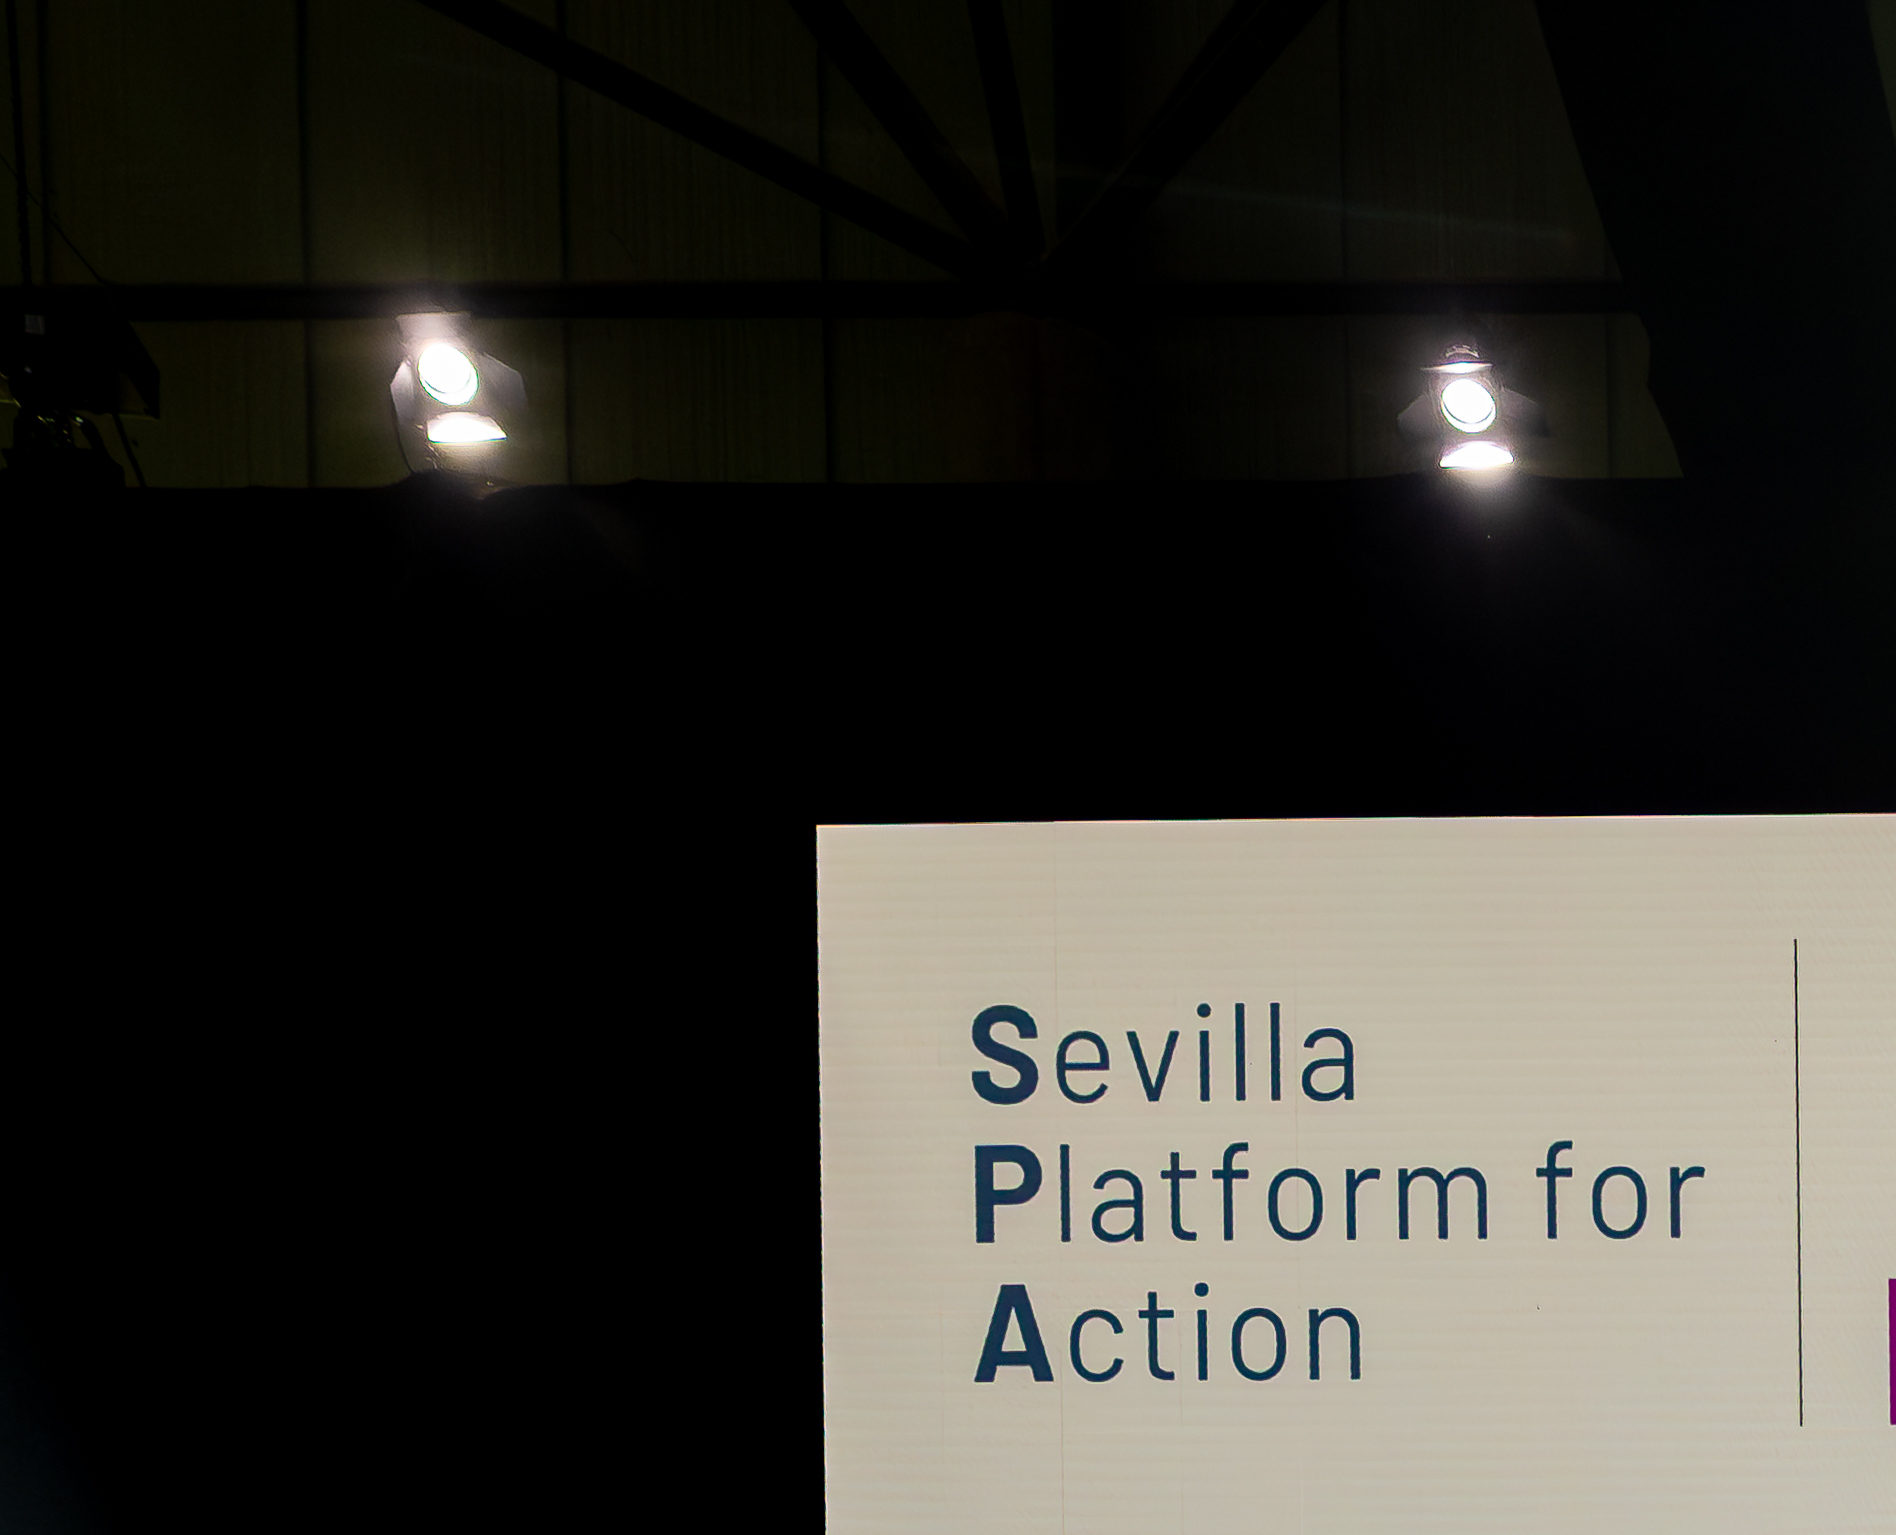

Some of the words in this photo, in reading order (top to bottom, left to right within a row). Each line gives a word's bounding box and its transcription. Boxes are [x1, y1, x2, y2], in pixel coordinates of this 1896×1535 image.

[971, 1002, 1356, 1106] Sevilla
[974, 1141, 1489, 1244] Platform
[1535, 1140, 1707, 1240] for
[974, 1282, 1362, 1383] Action
